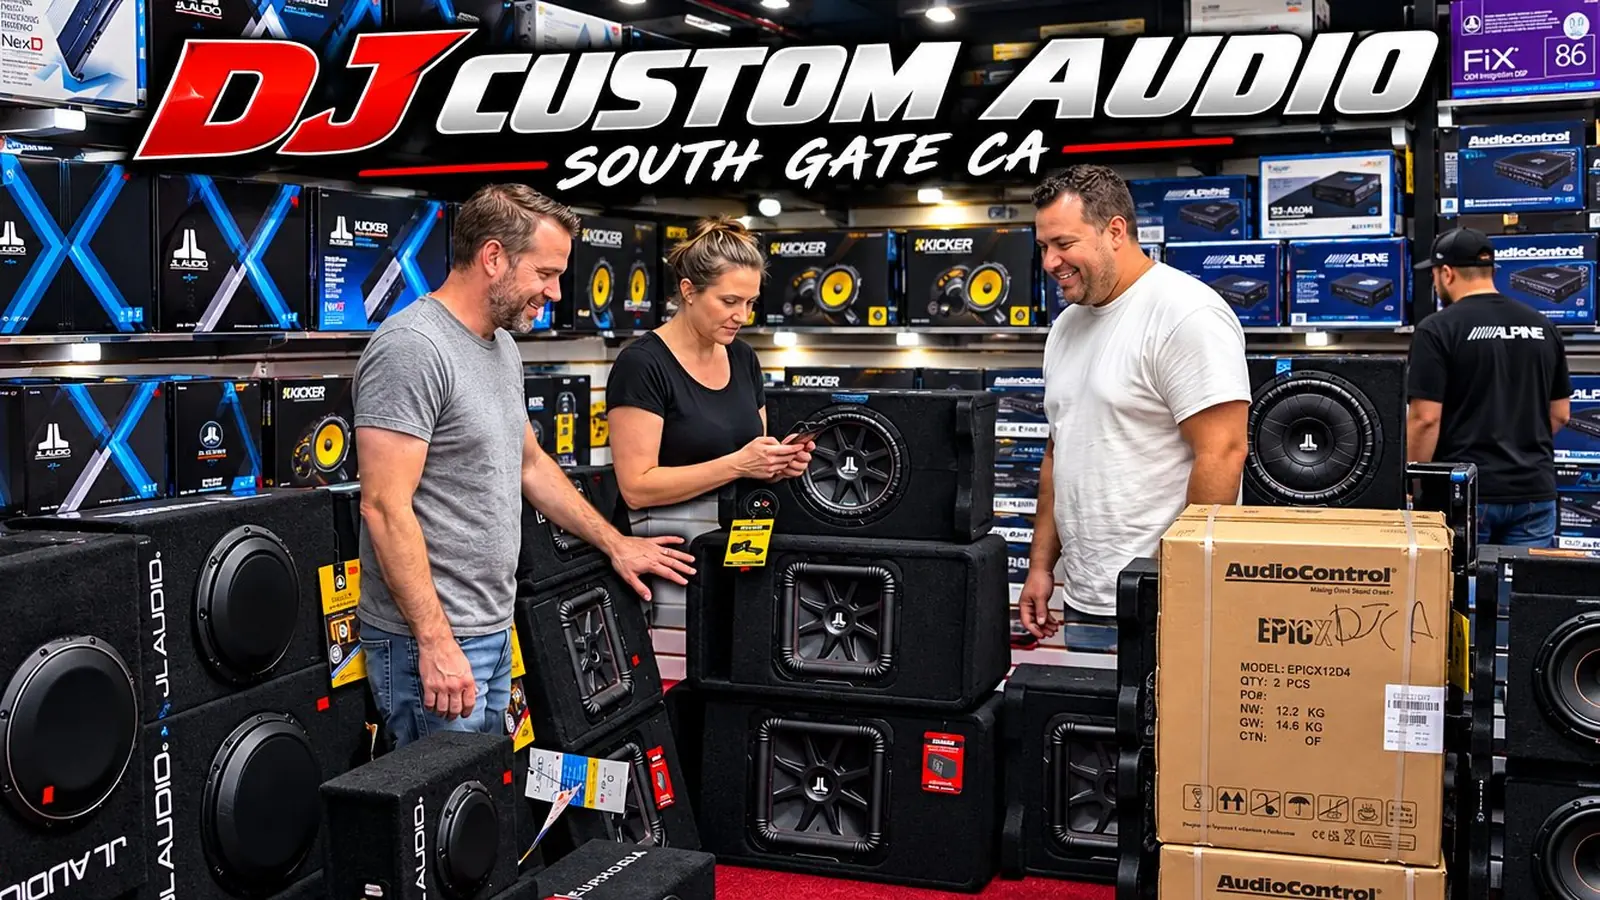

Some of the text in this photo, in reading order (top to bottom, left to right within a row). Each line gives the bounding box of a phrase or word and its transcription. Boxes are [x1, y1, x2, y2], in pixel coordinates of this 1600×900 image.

[1, 33, 43, 51] NexD
[1555, 43, 1587, 67] 86
[133, 28, 478, 160] DJ
[436, 41, 962, 134] CUSTOM
[977, 30, 1440, 120] AUDIO
[1468, 131, 1570, 146] AudioControl
[556, 129, 1050, 190] SOUTH GATE CA
[589, 229, 623, 245] KICKER
[780, 241, 826, 254] KICKER
[922, 238, 973, 252] KICKER
[1494, 245, 1584, 259] udioControl
[1224, 254, 1265, 264] ALPINE
[1345, 253, 1389, 263] ALPINE
[1492, 326, 1545, 340] ALPINE
[799, 375, 840, 387] KICKER
[290, 385, 325, 398] KICKER
[1225, 562, 1391, 583] AudioControl
[149, 559, 170, 698] JL AUDIO
[1240, 662, 1351, 678] MODEL: EPICX12D4
[1240, 676, 1311, 689] QTY: 2 PCS
[1240, 704, 1325, 718] NW: 12.2 KG
[1240, 717, 1323, 732] GW: 14.6 KG
[1239, 731, 1321, 746] CTN: OF
[154, 752, 175, 869] AUDIO
[93, 836, 127, 868] JL
[413, 803, 427, 889] AUDIO
[1217, 874, 1376, 900] AudioControl
